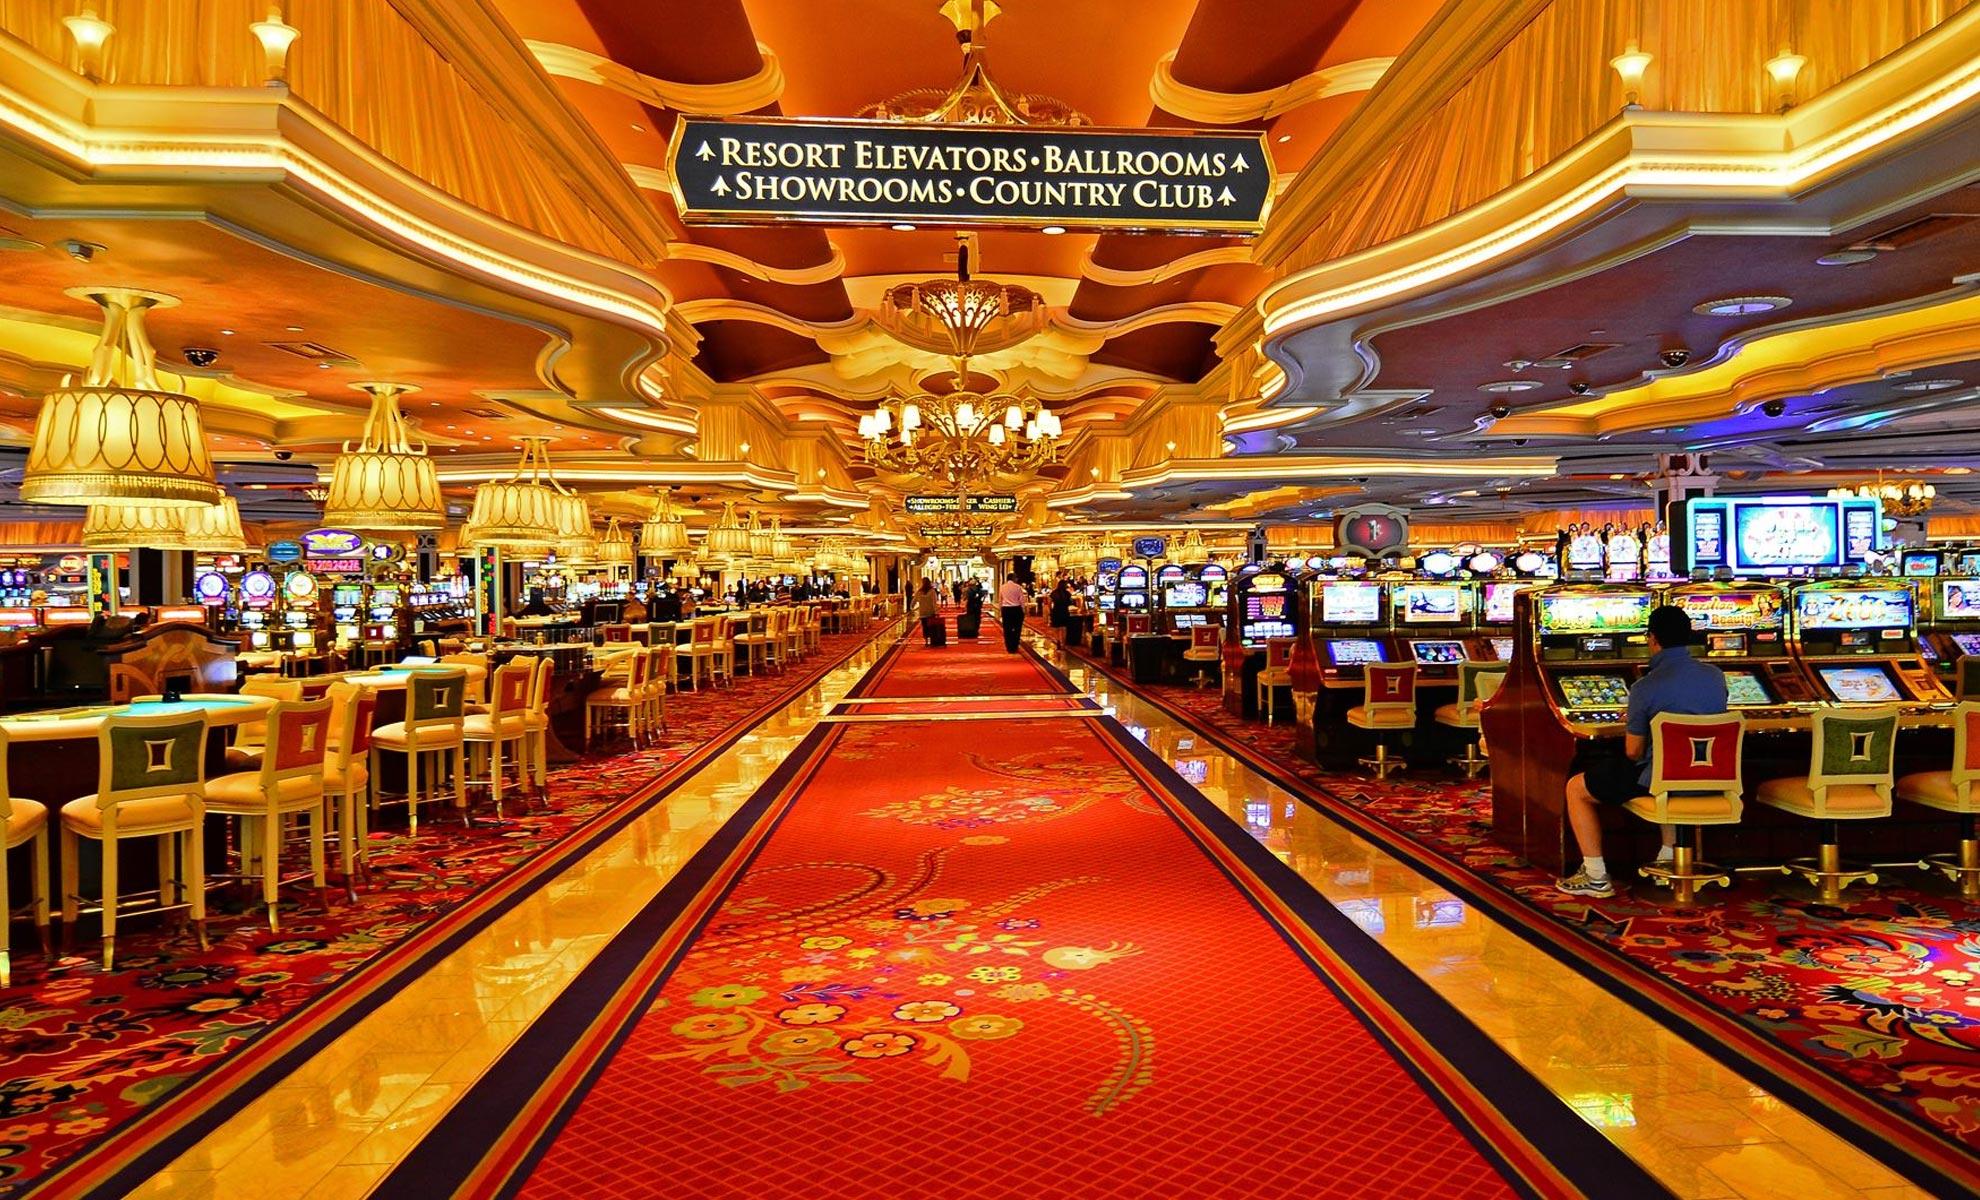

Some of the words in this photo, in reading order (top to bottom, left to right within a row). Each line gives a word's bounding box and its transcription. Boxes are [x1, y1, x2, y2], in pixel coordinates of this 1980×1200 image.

[720, 137, 845, 169] RESORT
[854, 140, 1027, 173] ELEVATORS
[1043, 145, 1226, 177] BALLROOMS
[735, 171, 952, 203] SHOWROOMS
[969, 176, 1127, 207] COUNTRY
[1133, 179, 1214, 209] CLUB
